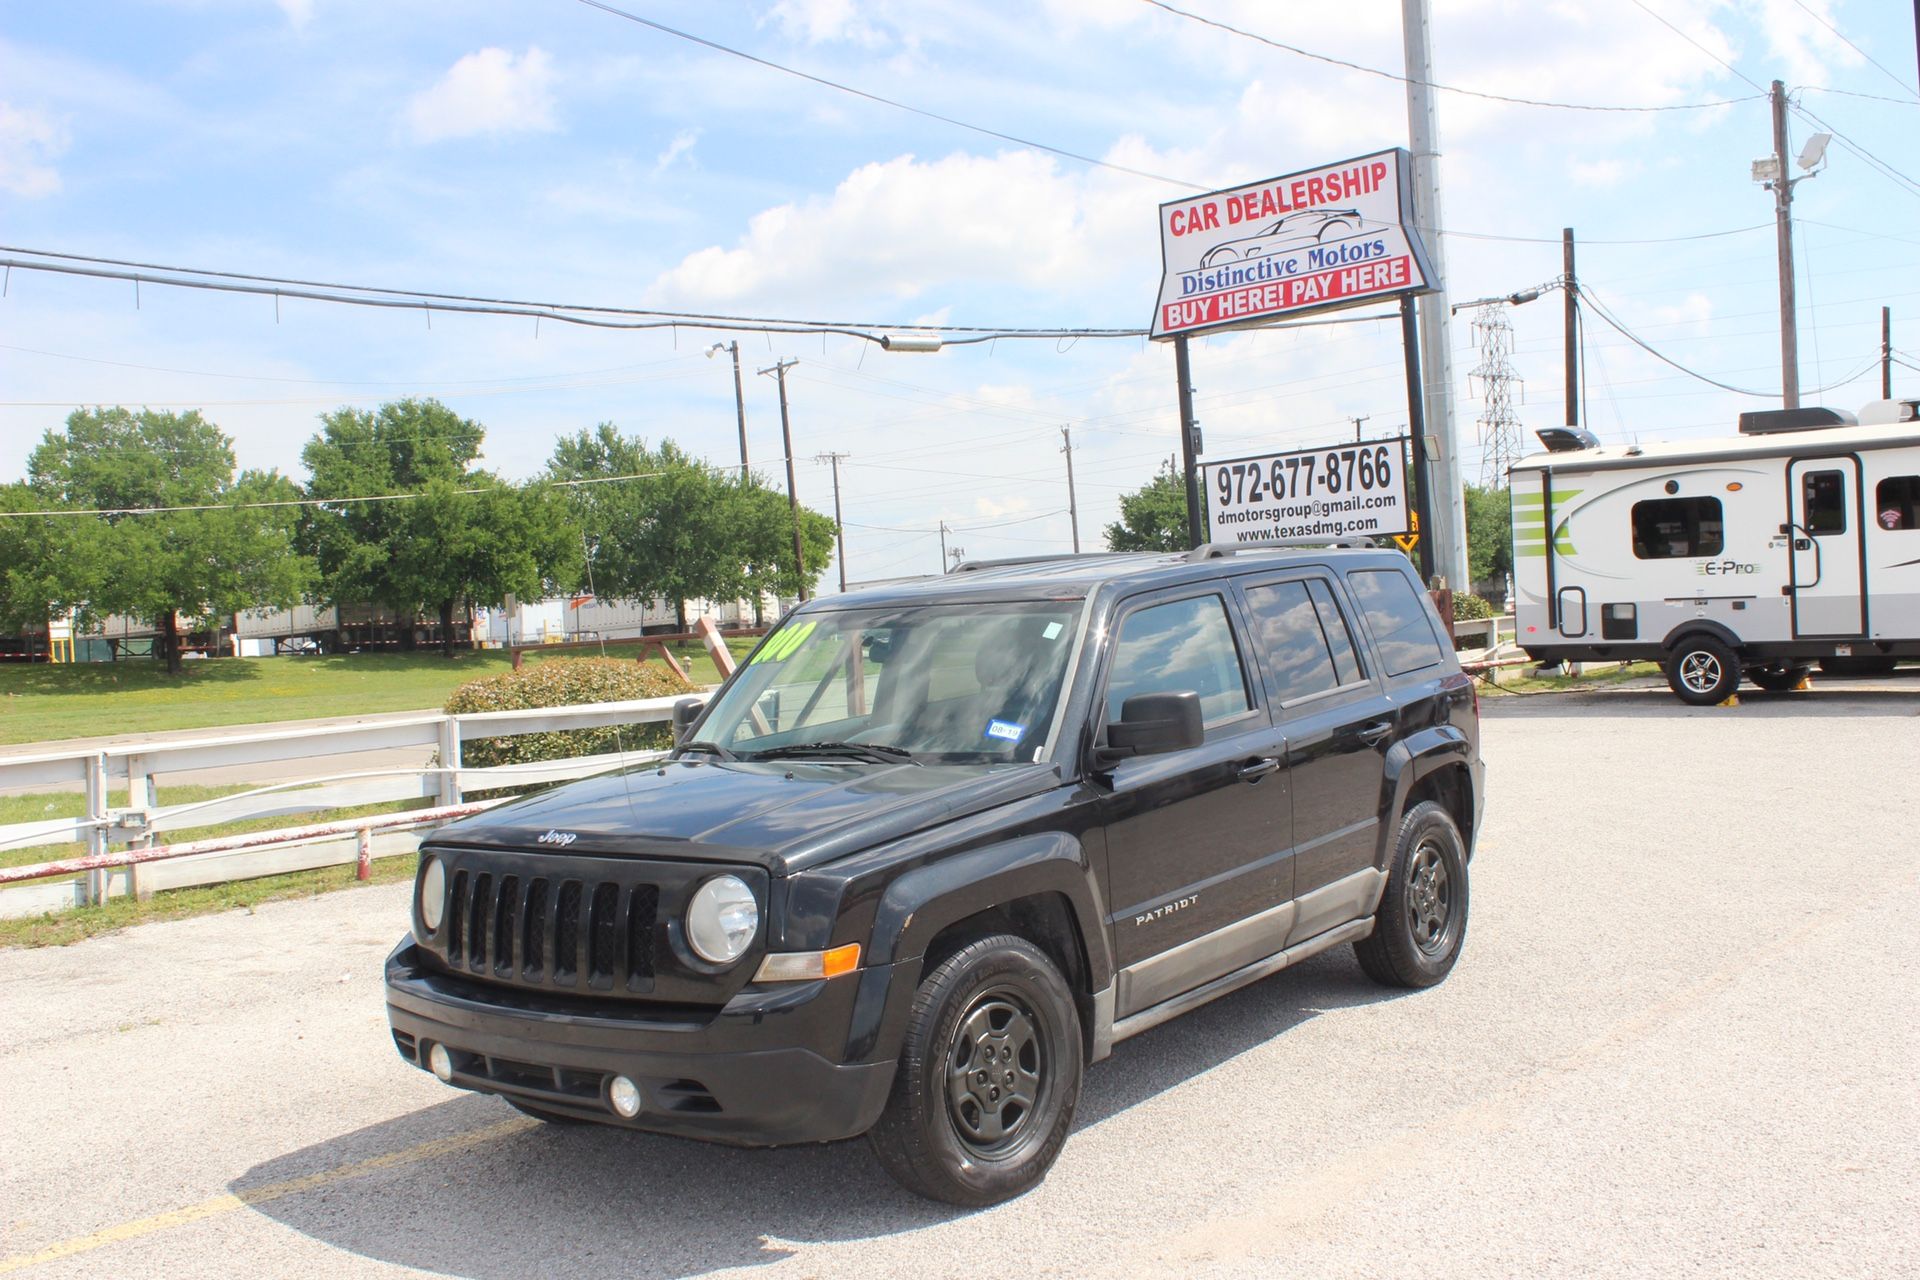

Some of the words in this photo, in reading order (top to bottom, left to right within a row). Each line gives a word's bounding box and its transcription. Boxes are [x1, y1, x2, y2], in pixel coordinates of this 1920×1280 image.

[1169, 202, 1220, 237] CAR
[1227, 162, 1387, 225] DEALERSHIP
[1182, 256, 1298, 295] Distinctive
[1308, 239, 1385, 269] Motors
[1167, 299, 1216, 328] BUY
[1218, 284, 1284, 318] HERE!
[1292, 273, 1338, 304] PAY
[1341, 259, 1405, 294] HERE
[1217, 446, 1391, 507] 972-677-8766
[1218, 494, 1396, 525] dmotorsgroup@gmail.com
[1237, 517, 1378, 542] www.texasdmg.com
[1705, 561, 1755, 575] E-Pro
[537, 829, 577, 848] Jeep
[1135, 894, 1199, 926] PATRIOT
